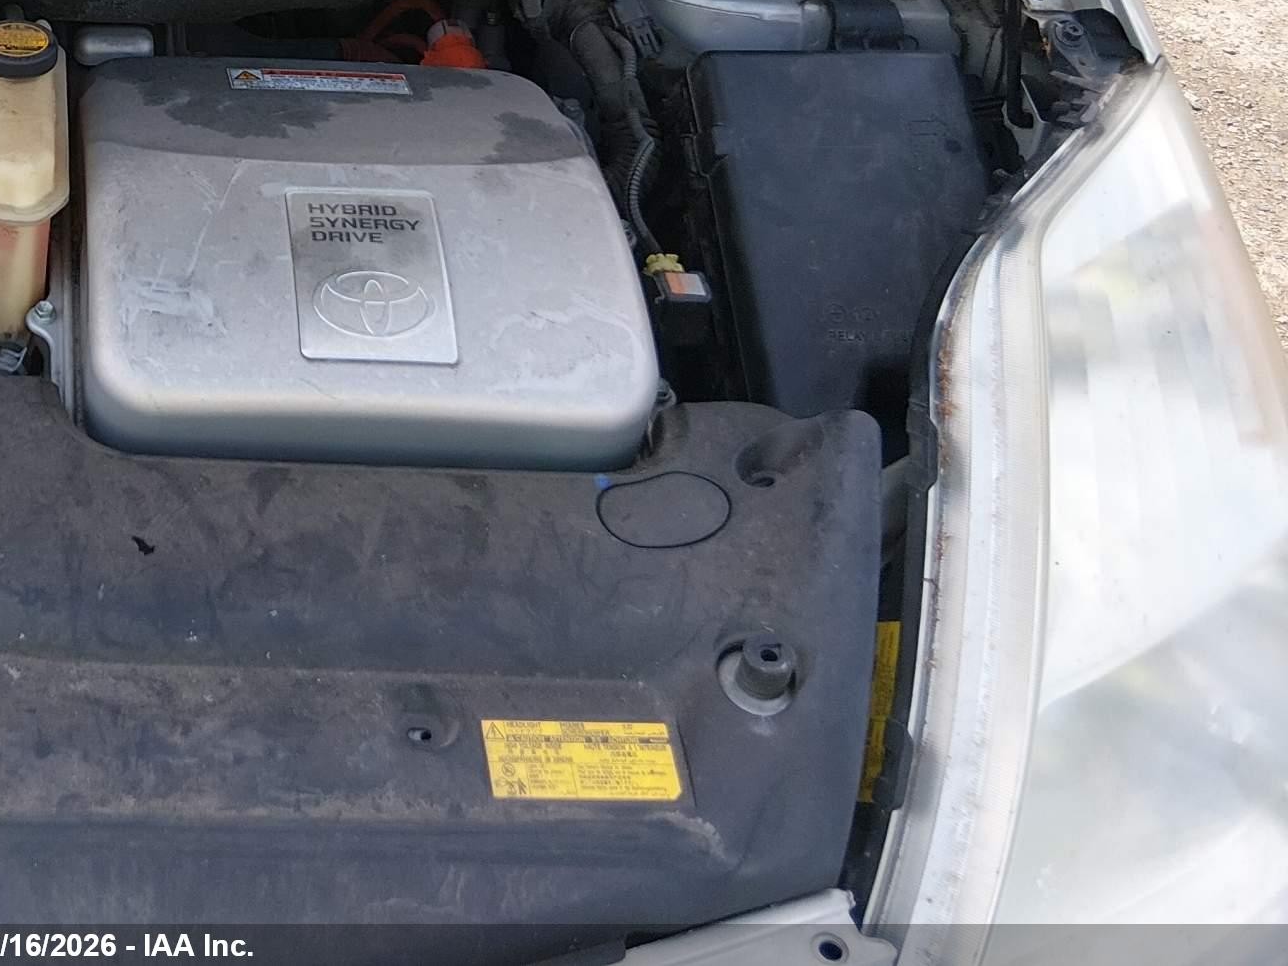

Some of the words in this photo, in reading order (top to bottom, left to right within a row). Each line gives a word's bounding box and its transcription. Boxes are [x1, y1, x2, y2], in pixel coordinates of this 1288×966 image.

[308, 203, 397, 216] HYBRID
[310, 217, 420, 231] SYNERGY
[312, 231, 384, 243] DRIVE
